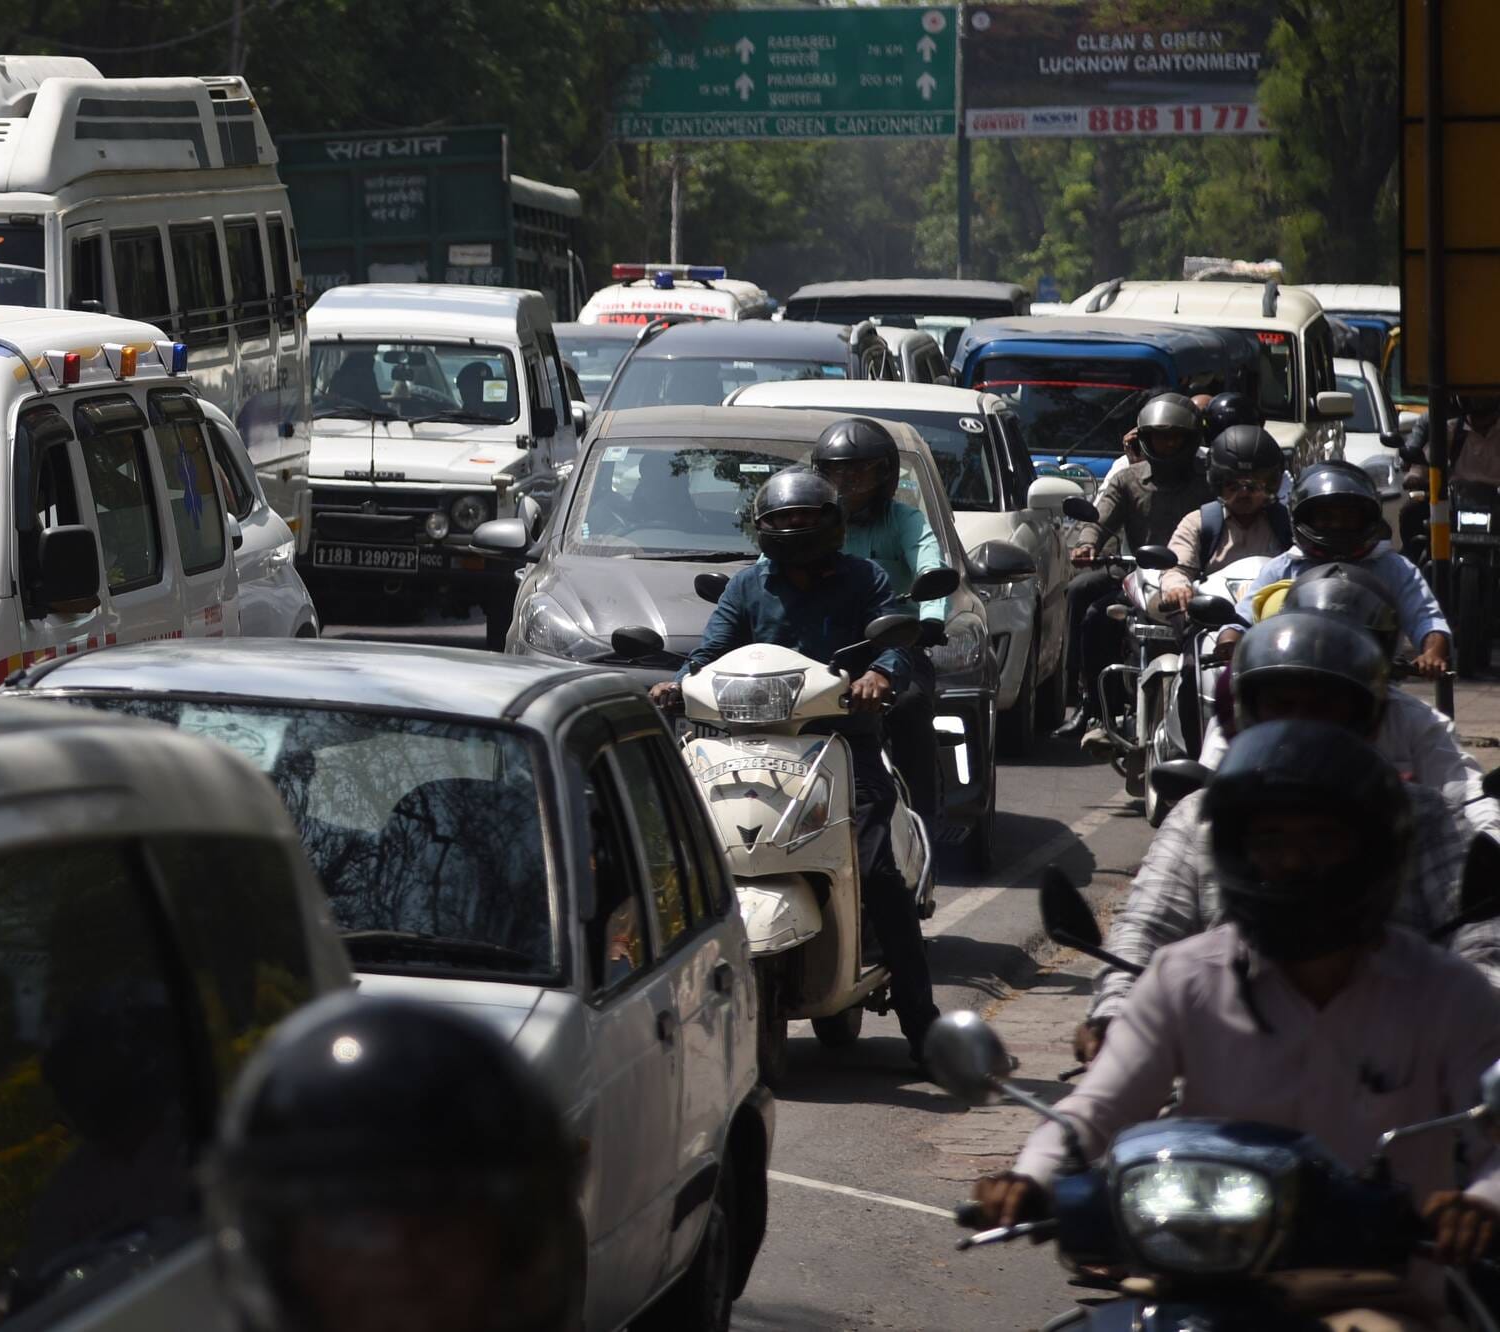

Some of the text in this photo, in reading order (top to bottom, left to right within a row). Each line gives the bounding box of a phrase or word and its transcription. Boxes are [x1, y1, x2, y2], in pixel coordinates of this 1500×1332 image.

[1076, 34, 1136, 51] CLEAN
[1038, 53, 1261, 74] LUCKNOW CANTONMENT
[662, 116, 768, 135] CANTONMENT
[776, 116, 827, 135] GREEN
[835, 115, 944, 134] CANTONMENT
[1087, 106, 1158, 132] 888
[1170, 106, 1202, 131] 11
[324, 135, 449, 161] सावधान
[631, 301, 683, 312] Health
[689, 303, 727, 314] Care
